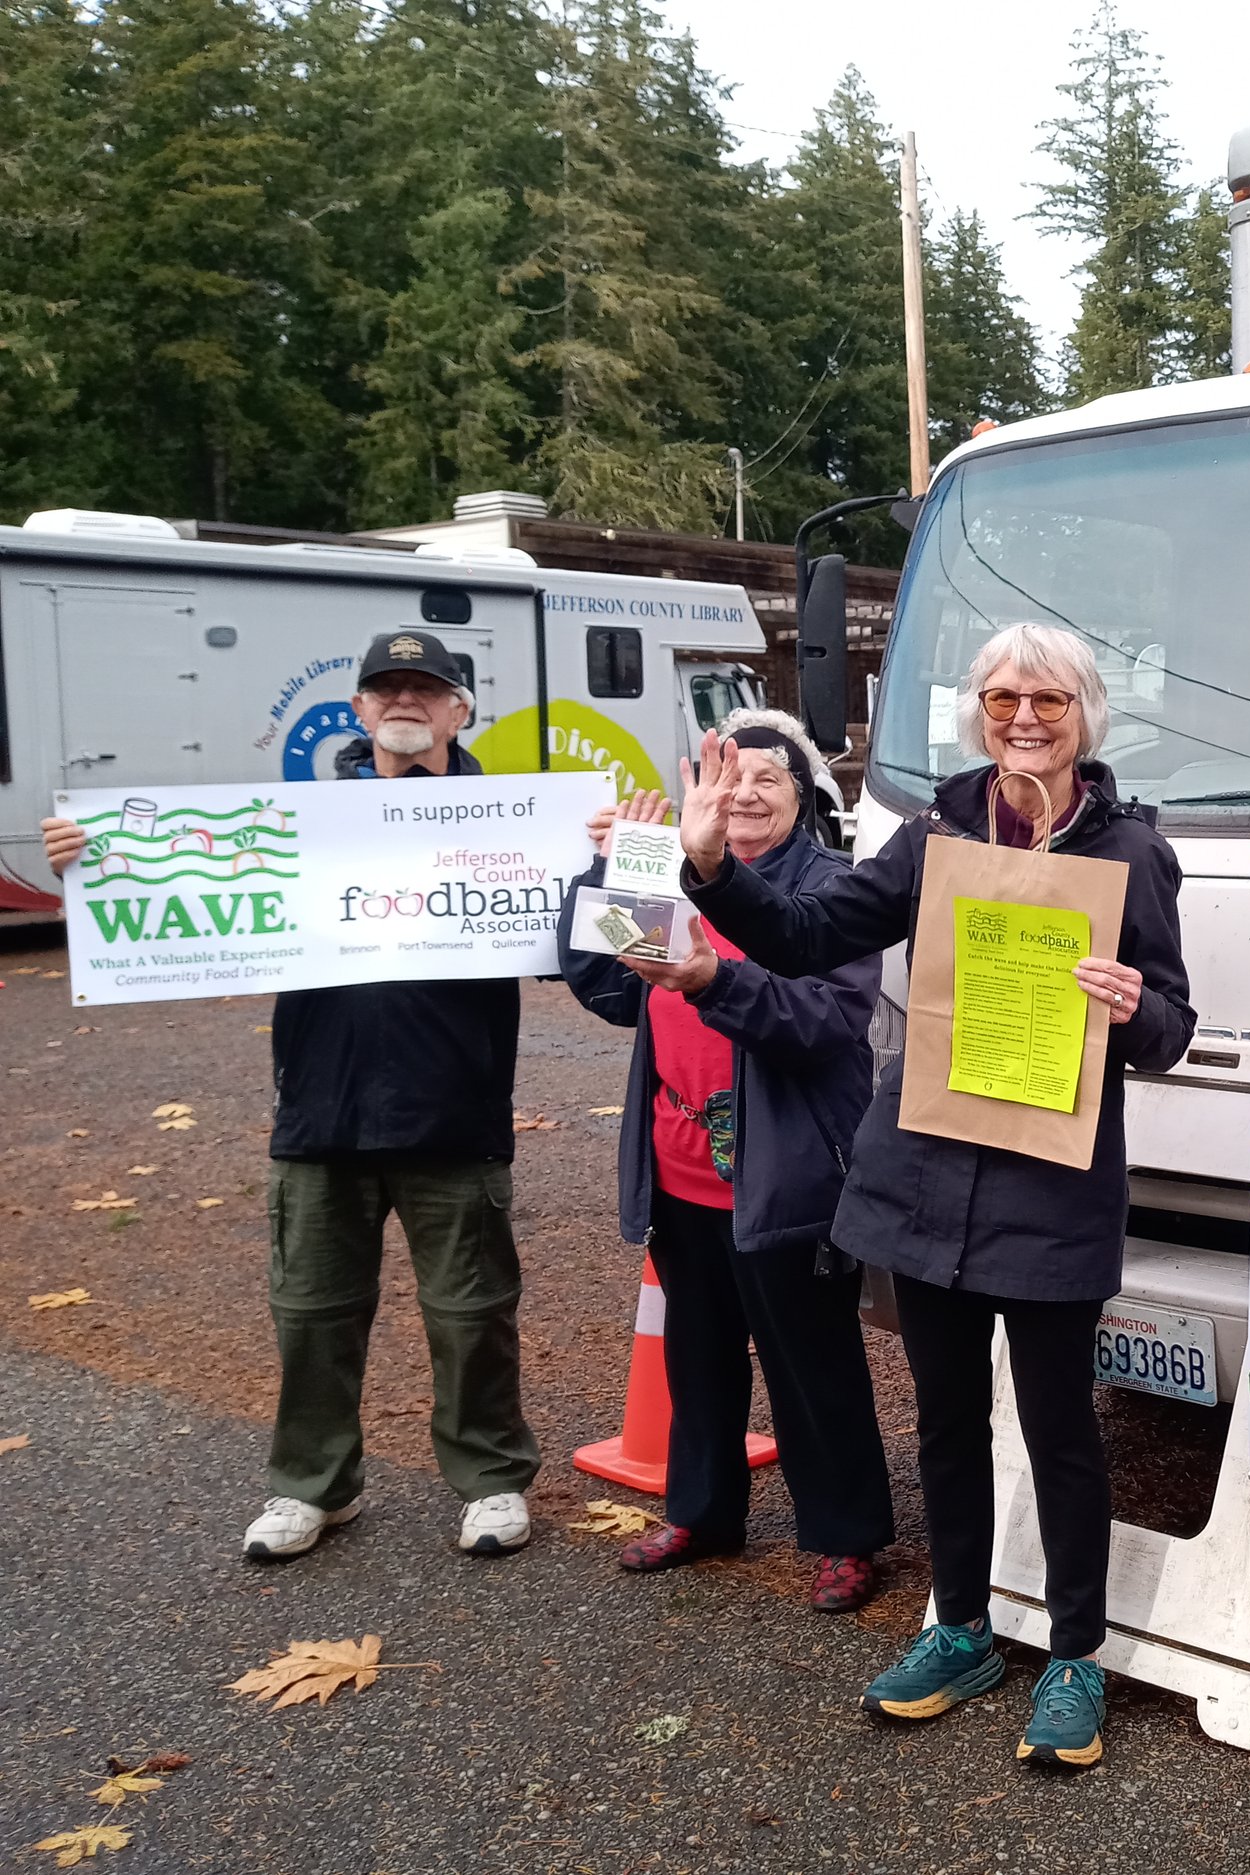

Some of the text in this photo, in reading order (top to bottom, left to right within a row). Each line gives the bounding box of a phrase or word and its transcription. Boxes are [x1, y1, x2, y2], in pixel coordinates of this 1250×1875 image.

[543, 594, 746, 623] JEFFERSON COUNTY LIBRARY
[253, 655, 355, 751] Your Mobile Library
[382, 796, 536, 825] in support of
[433, 849, 525, 868] Jefferson
[473, 867, 547, 884] County
[86, 890, 298, 944] W.A.V.E.
[460, 914, 558, 934] Associati
[398, 941, 420, 952] Port
[422, 940, 474, 951] Townsend
[491, 938, 537, 950] Quilcene
[90, 946, 305, 970] What A Valuable Experience
[115, 964, 284, 987] Community Food Drive
[1098, 1313, 1158, 1335] SHINGTON
[1096, 1329, 1206, 1391] 69386B
[1109, 1373, 1179, 1395] EVERGREEN STATE
